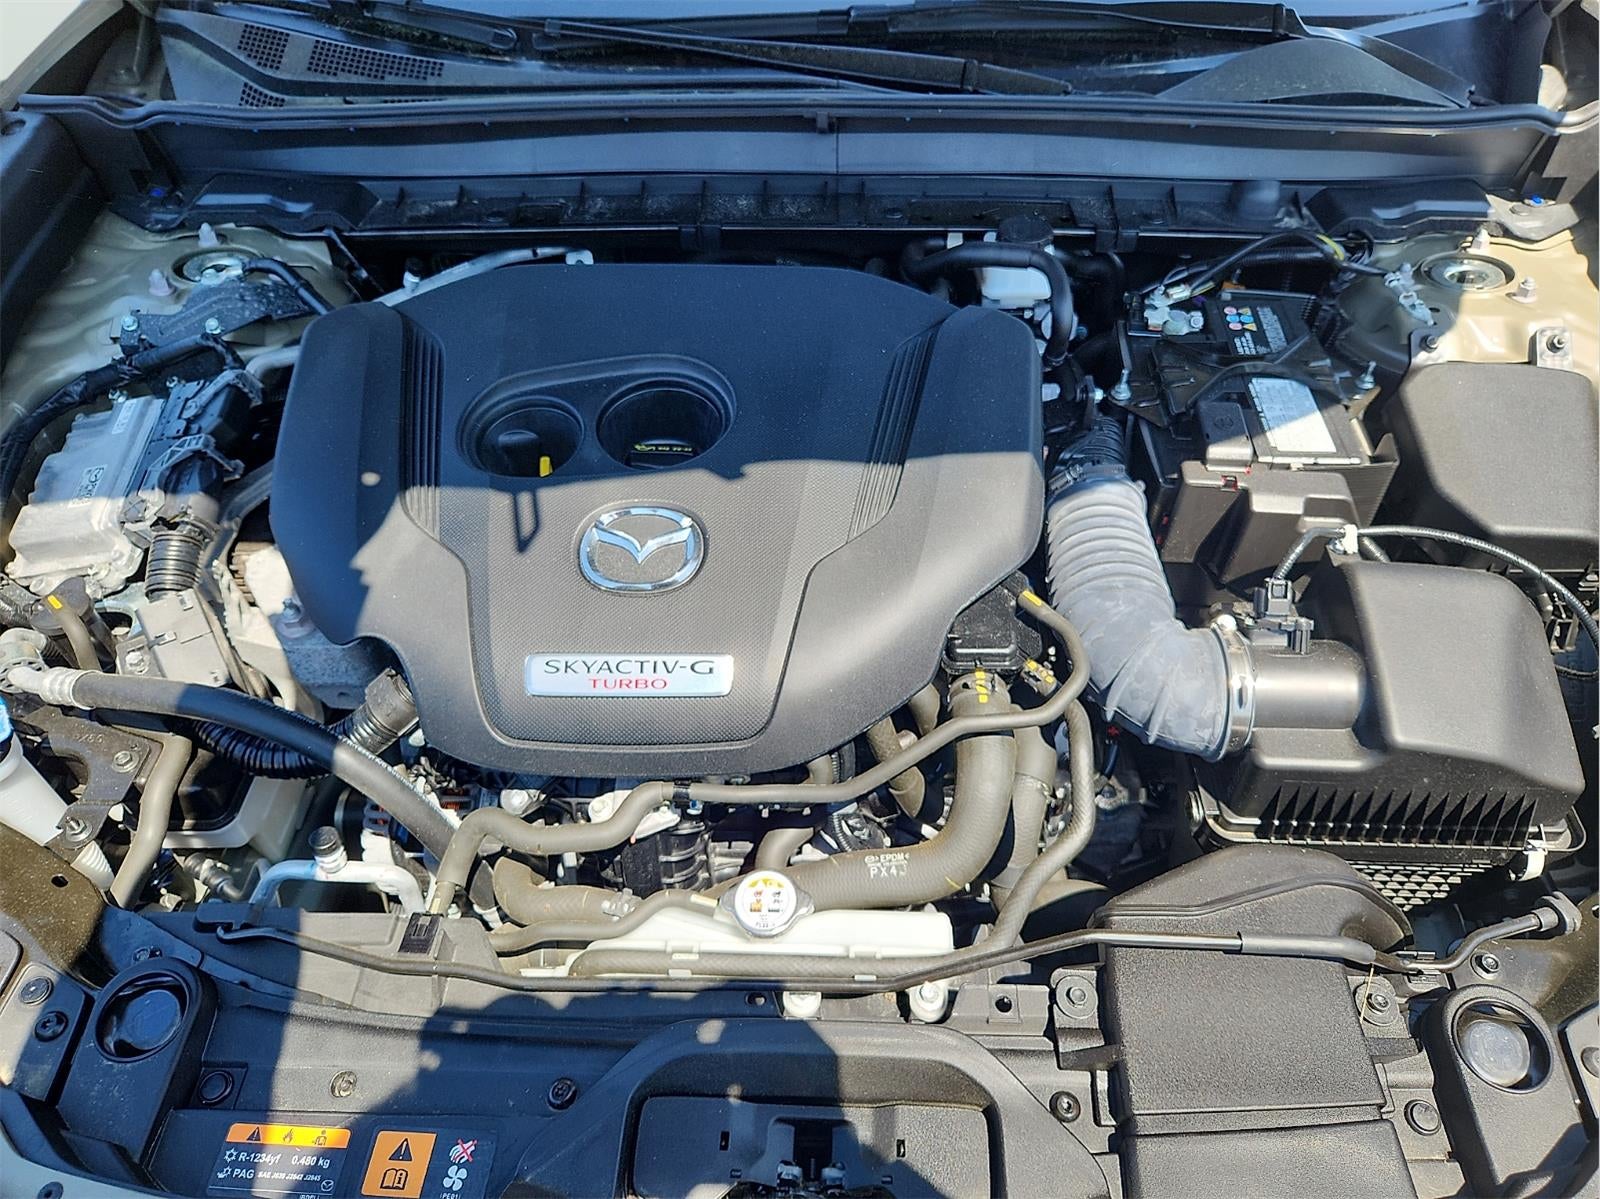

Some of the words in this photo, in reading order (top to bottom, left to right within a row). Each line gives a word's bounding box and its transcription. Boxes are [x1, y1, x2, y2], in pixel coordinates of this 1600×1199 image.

[543, 659, 715, 675] SKYACTIV-G
[588, 678, 668, 690] TURBO
[239, 1151, 281, 1165] R-1234yf
[291, 1155, 317, 1166] 0.480
[319, 1157, 331, 1168] kg
[232, 1168, 255, 1179] PAG
